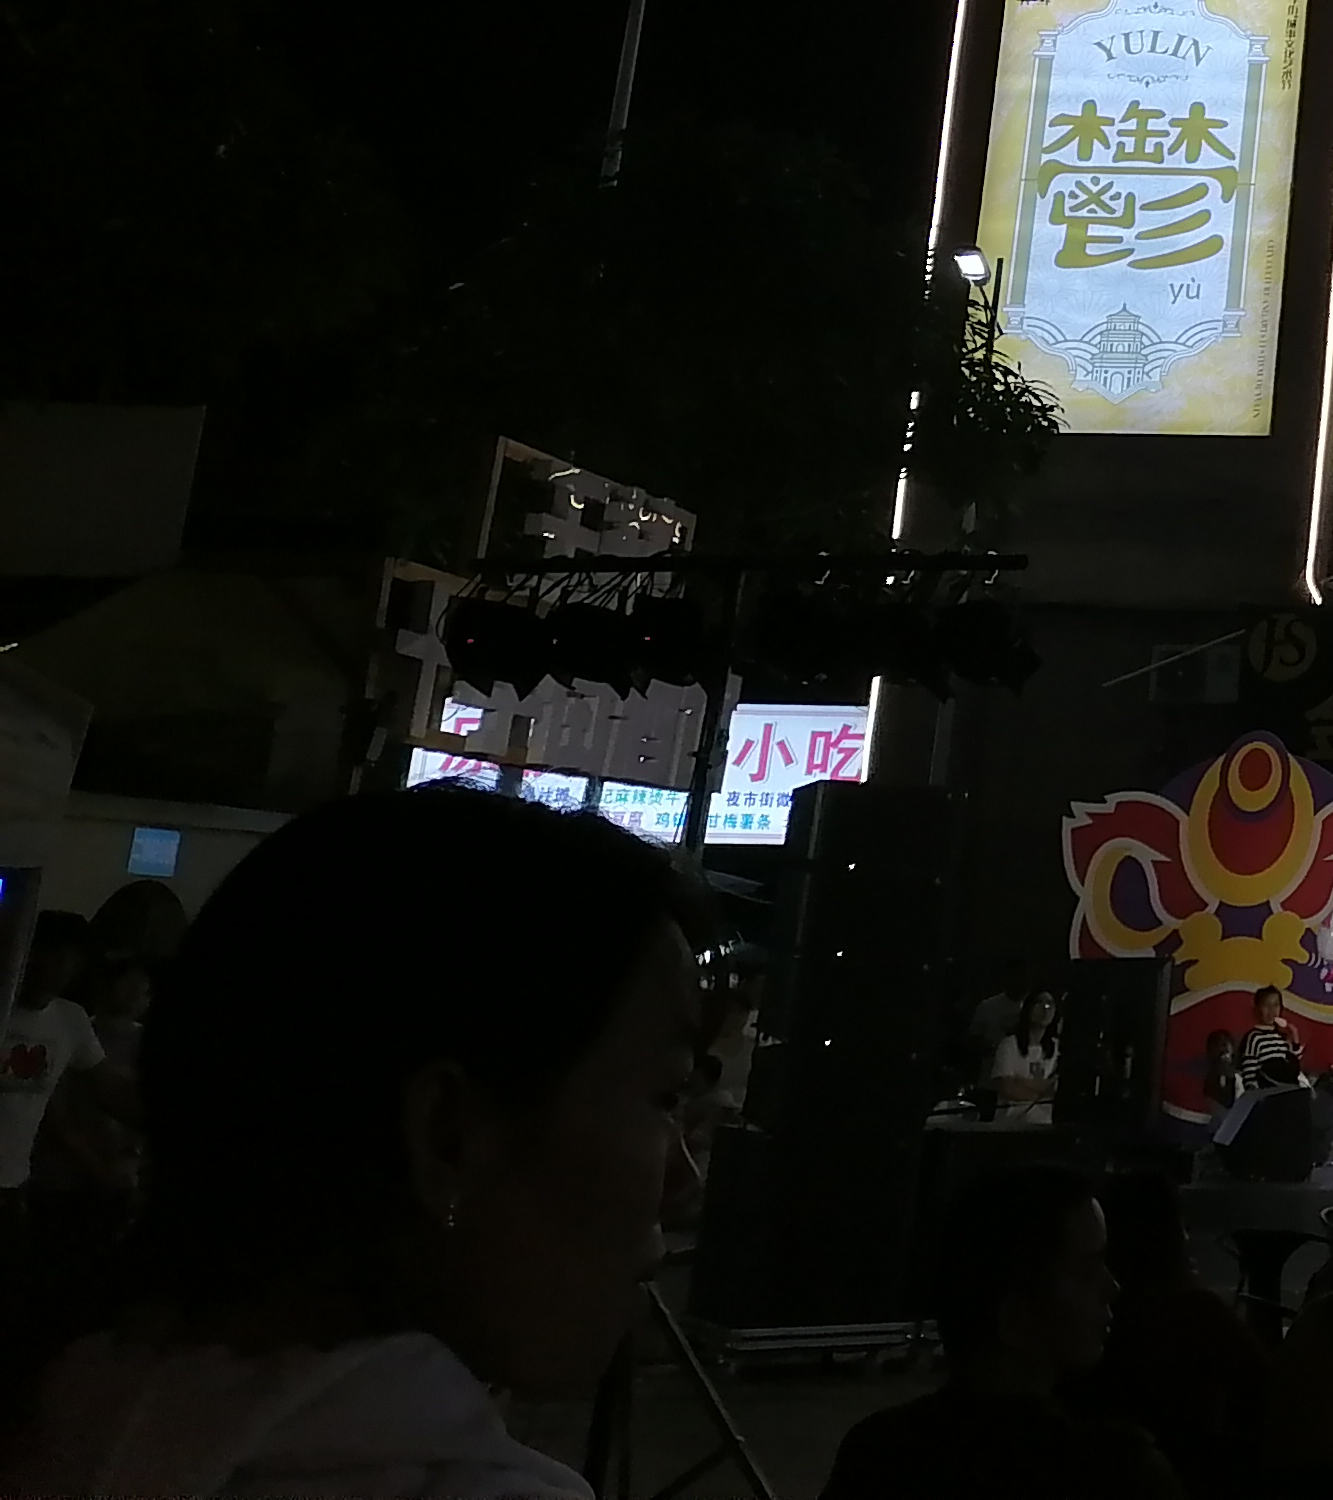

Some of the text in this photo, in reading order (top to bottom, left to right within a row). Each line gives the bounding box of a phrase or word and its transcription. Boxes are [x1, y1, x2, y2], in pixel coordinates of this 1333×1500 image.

[1093, 27, 1213, 68] YULIN
[1169, 277, 1202, 304] yù
[732, 722, 866, 784] 小吃
